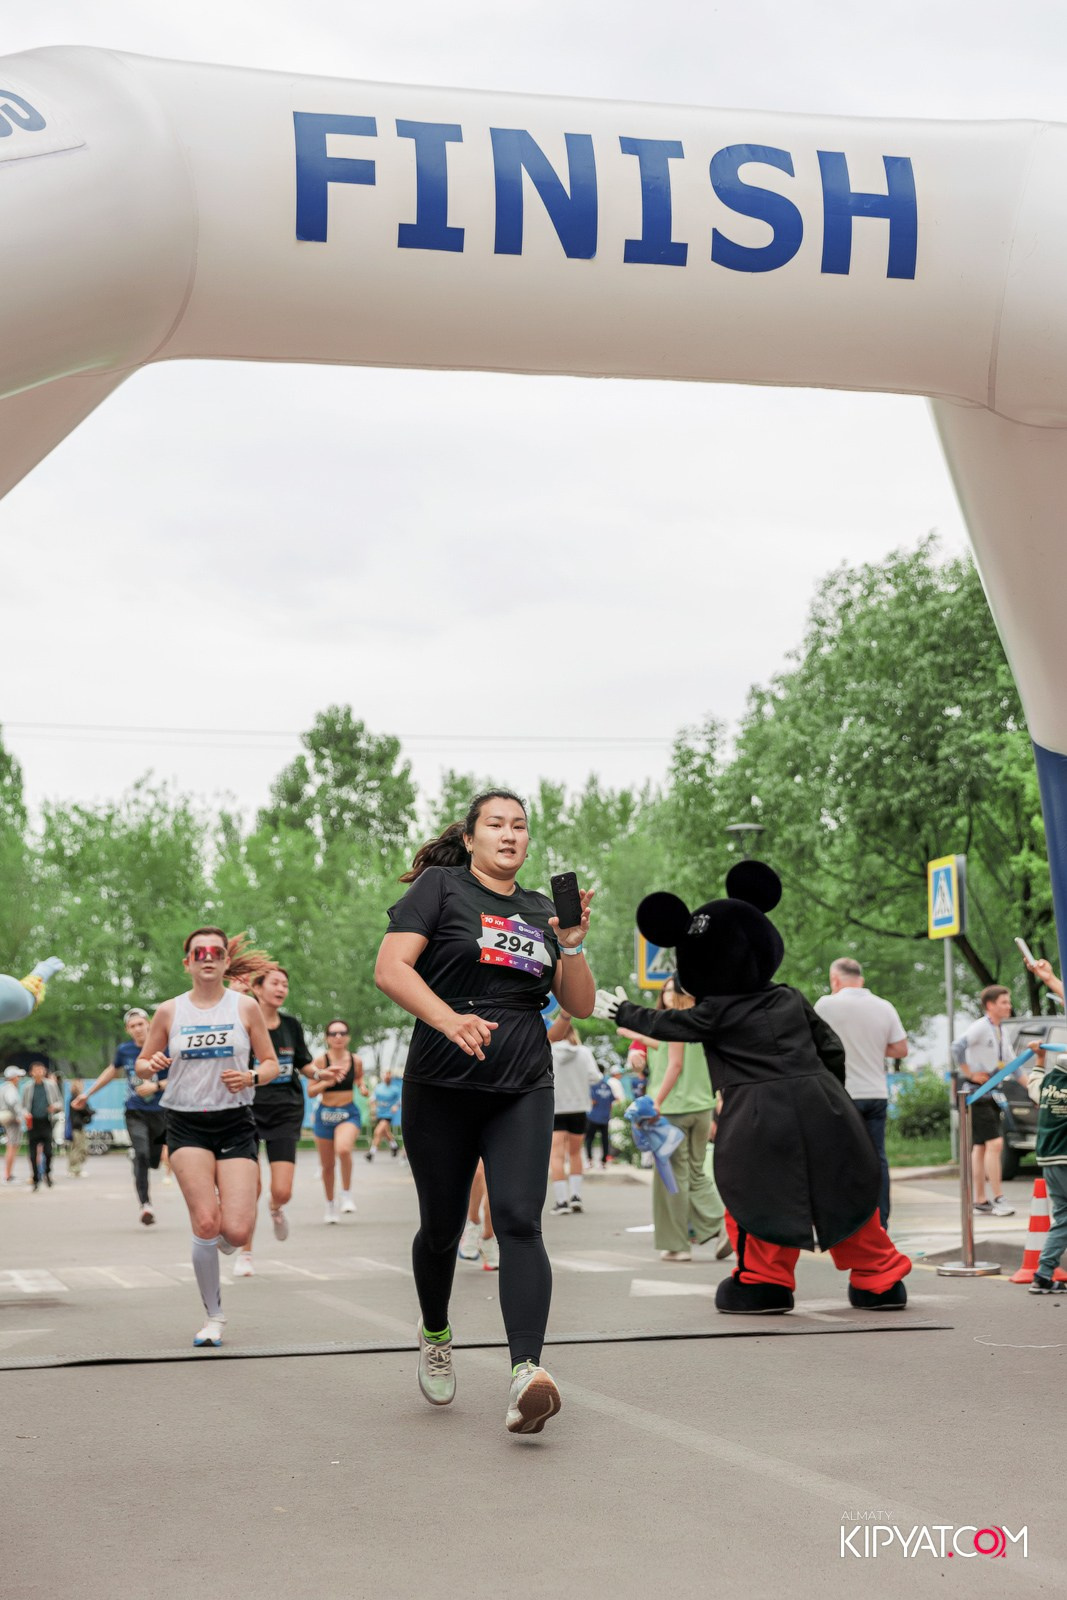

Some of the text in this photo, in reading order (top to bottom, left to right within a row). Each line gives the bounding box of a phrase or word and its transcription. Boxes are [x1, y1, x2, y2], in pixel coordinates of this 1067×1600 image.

[293, 111, 918, 280] FINISH
[494, 933, 535, 957] 294
[187, 1032, 228, 1048] 1303
